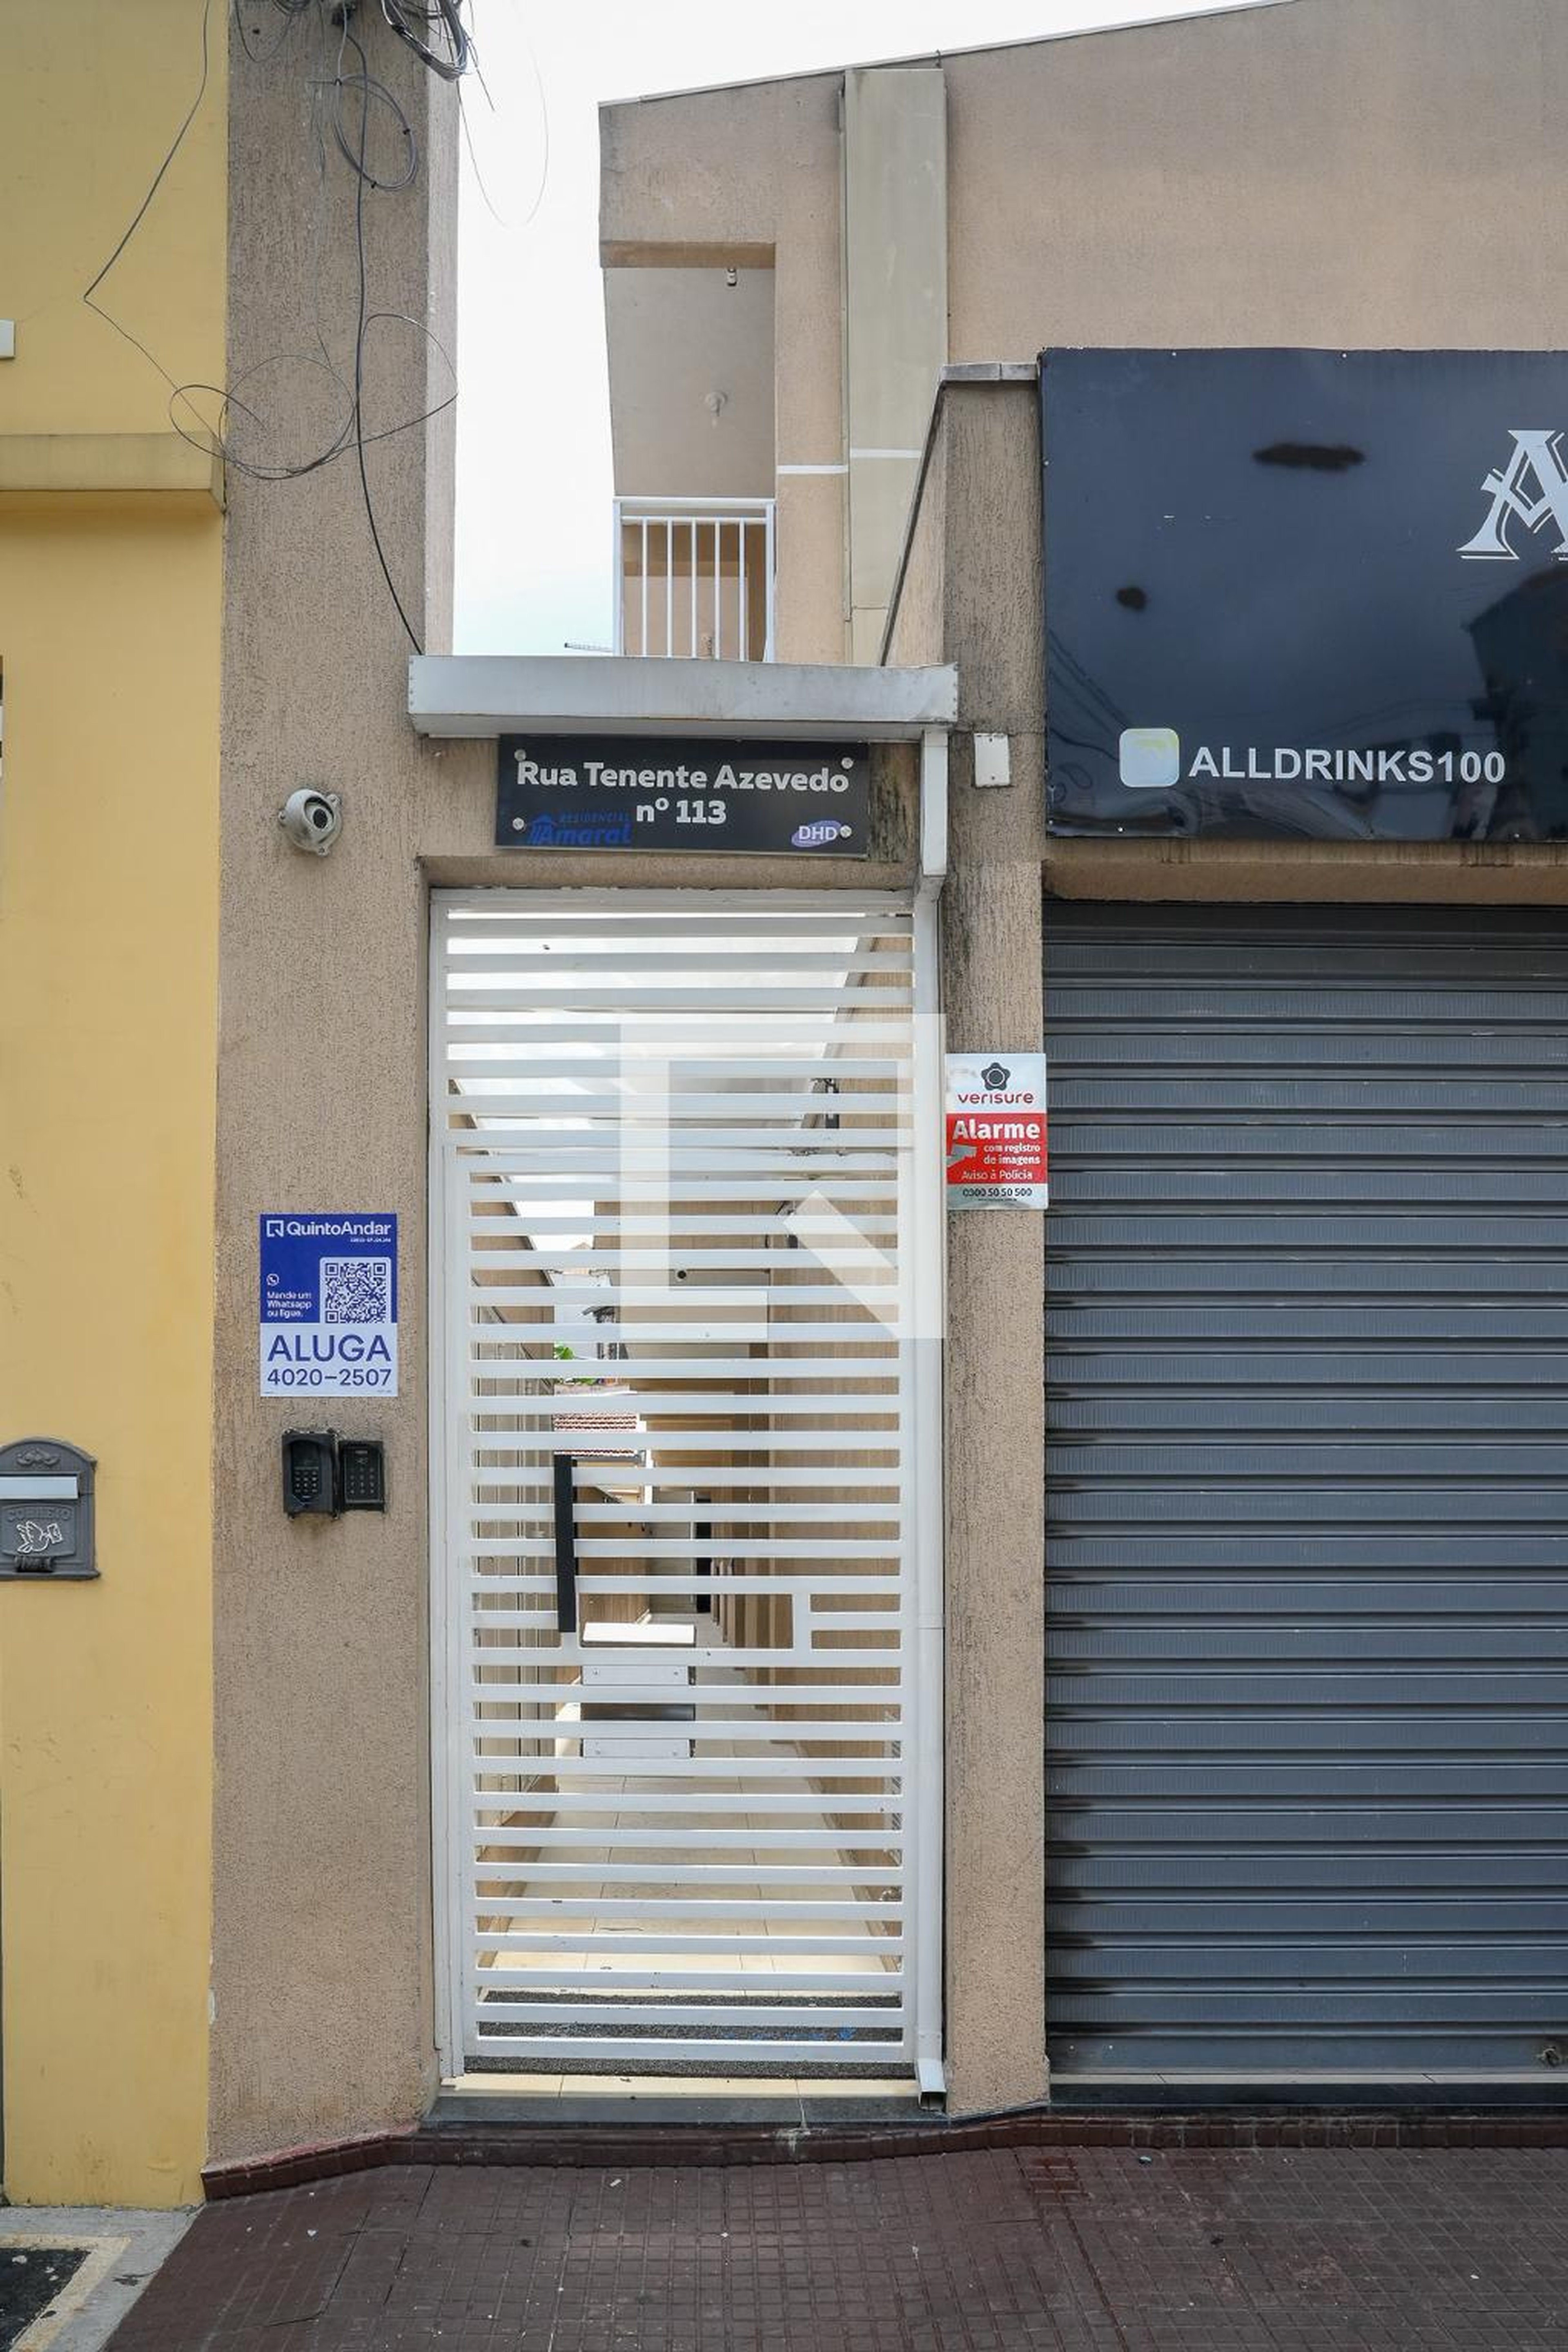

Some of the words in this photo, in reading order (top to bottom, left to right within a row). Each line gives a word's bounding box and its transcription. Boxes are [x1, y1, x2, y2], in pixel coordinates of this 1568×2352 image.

[1188, 746, 1506, 783] ALLDRINKS100
[517, 762, 577, 785] Rua
[584, 762, 707, 788] Tenente
[713, 765, 849, 792] Azevedo
[677, 800, 726, 824] 113
[799, 825, 837, 840] DHD
[958, 1093, 1034, 1103] verisure
[952, 1119, 1040, 1140] Alarme
[1004, 1143, 1040, 1153] registro
[999, 1155, 1040, 1165] imagens
[961, 1170, 988, 1179] Aviso
[999, 1169, 1033, 1179] Polícia
[287, 1221, 391, 1236] QuintoAndar
[268, 1334, 391, 1362] ALUGA
[267, 1369, 391, 1386] 4020-2507
